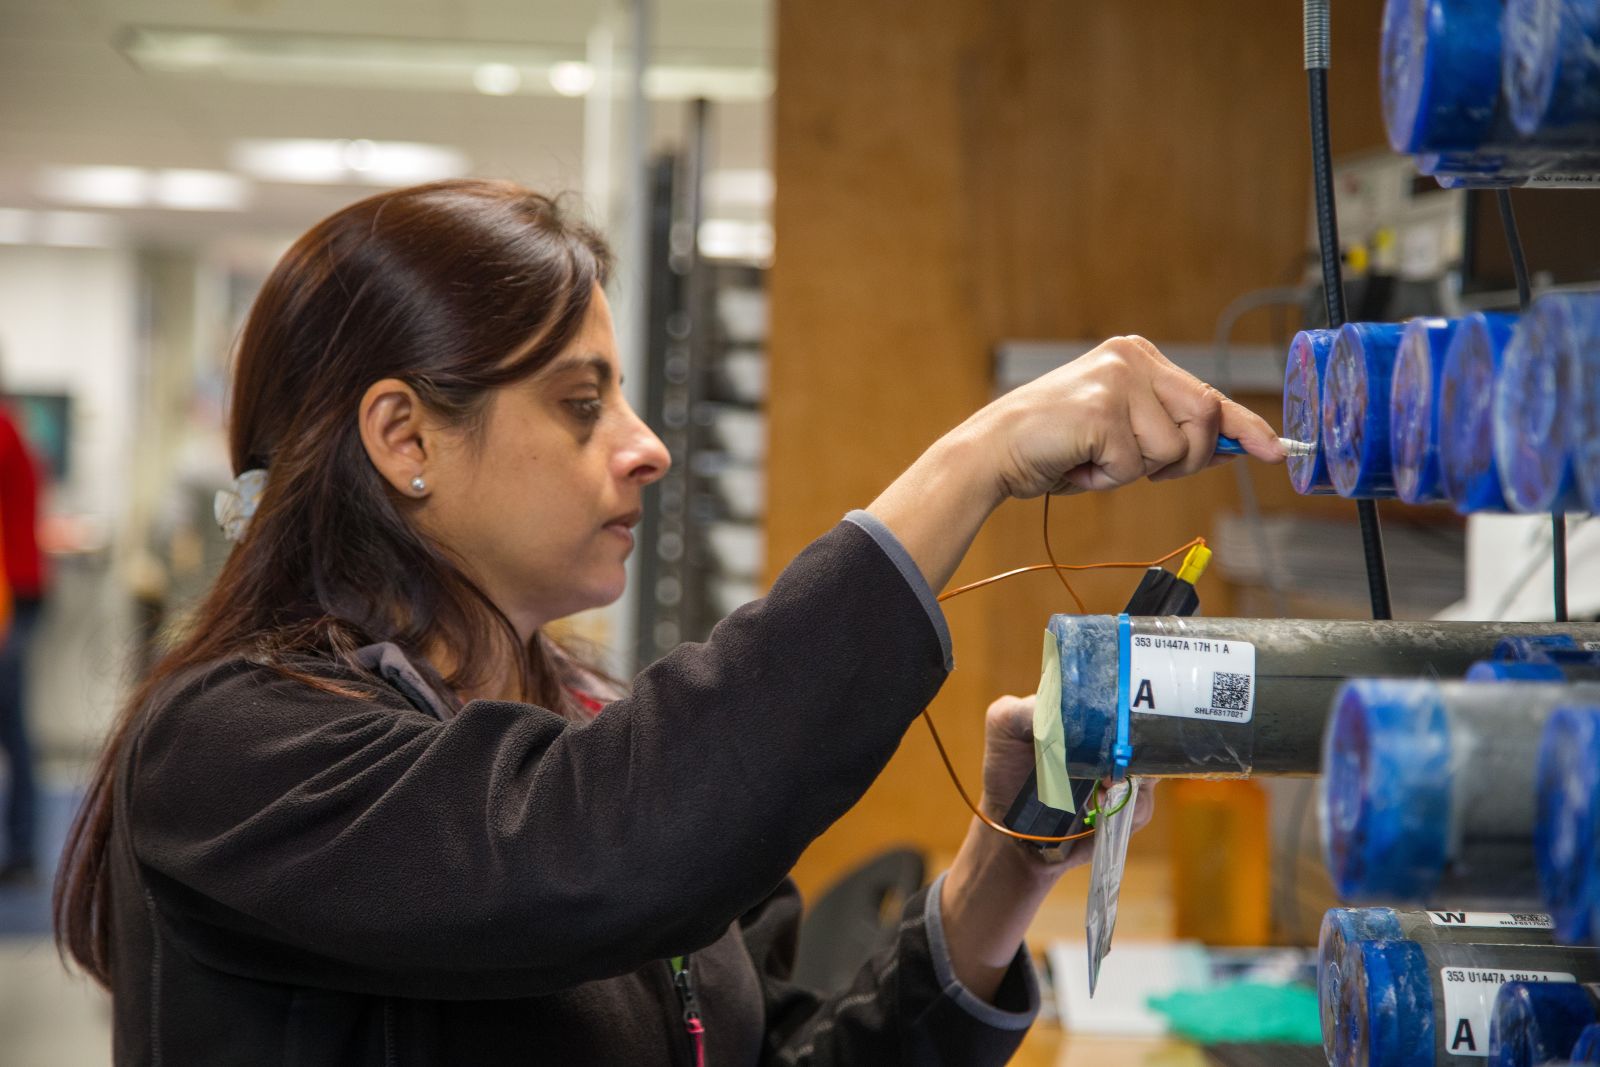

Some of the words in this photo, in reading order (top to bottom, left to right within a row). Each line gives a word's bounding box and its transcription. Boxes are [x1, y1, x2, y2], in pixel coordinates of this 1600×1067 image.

[1135, 637, 1151, 647] 353
[1155, 639, 1190, 650] U1447A
[1194, 642, 1211, 652] 17H
[1214, 644, 1219, 653] 1
[1223, 644, 1230, 654] A
[1132, 679, 1155, 709] A
[1446, 971, 1465, 982] 353
[1469, 972, 1507, 983] U1447A
[1451, 1018, 1477, 1051] A
